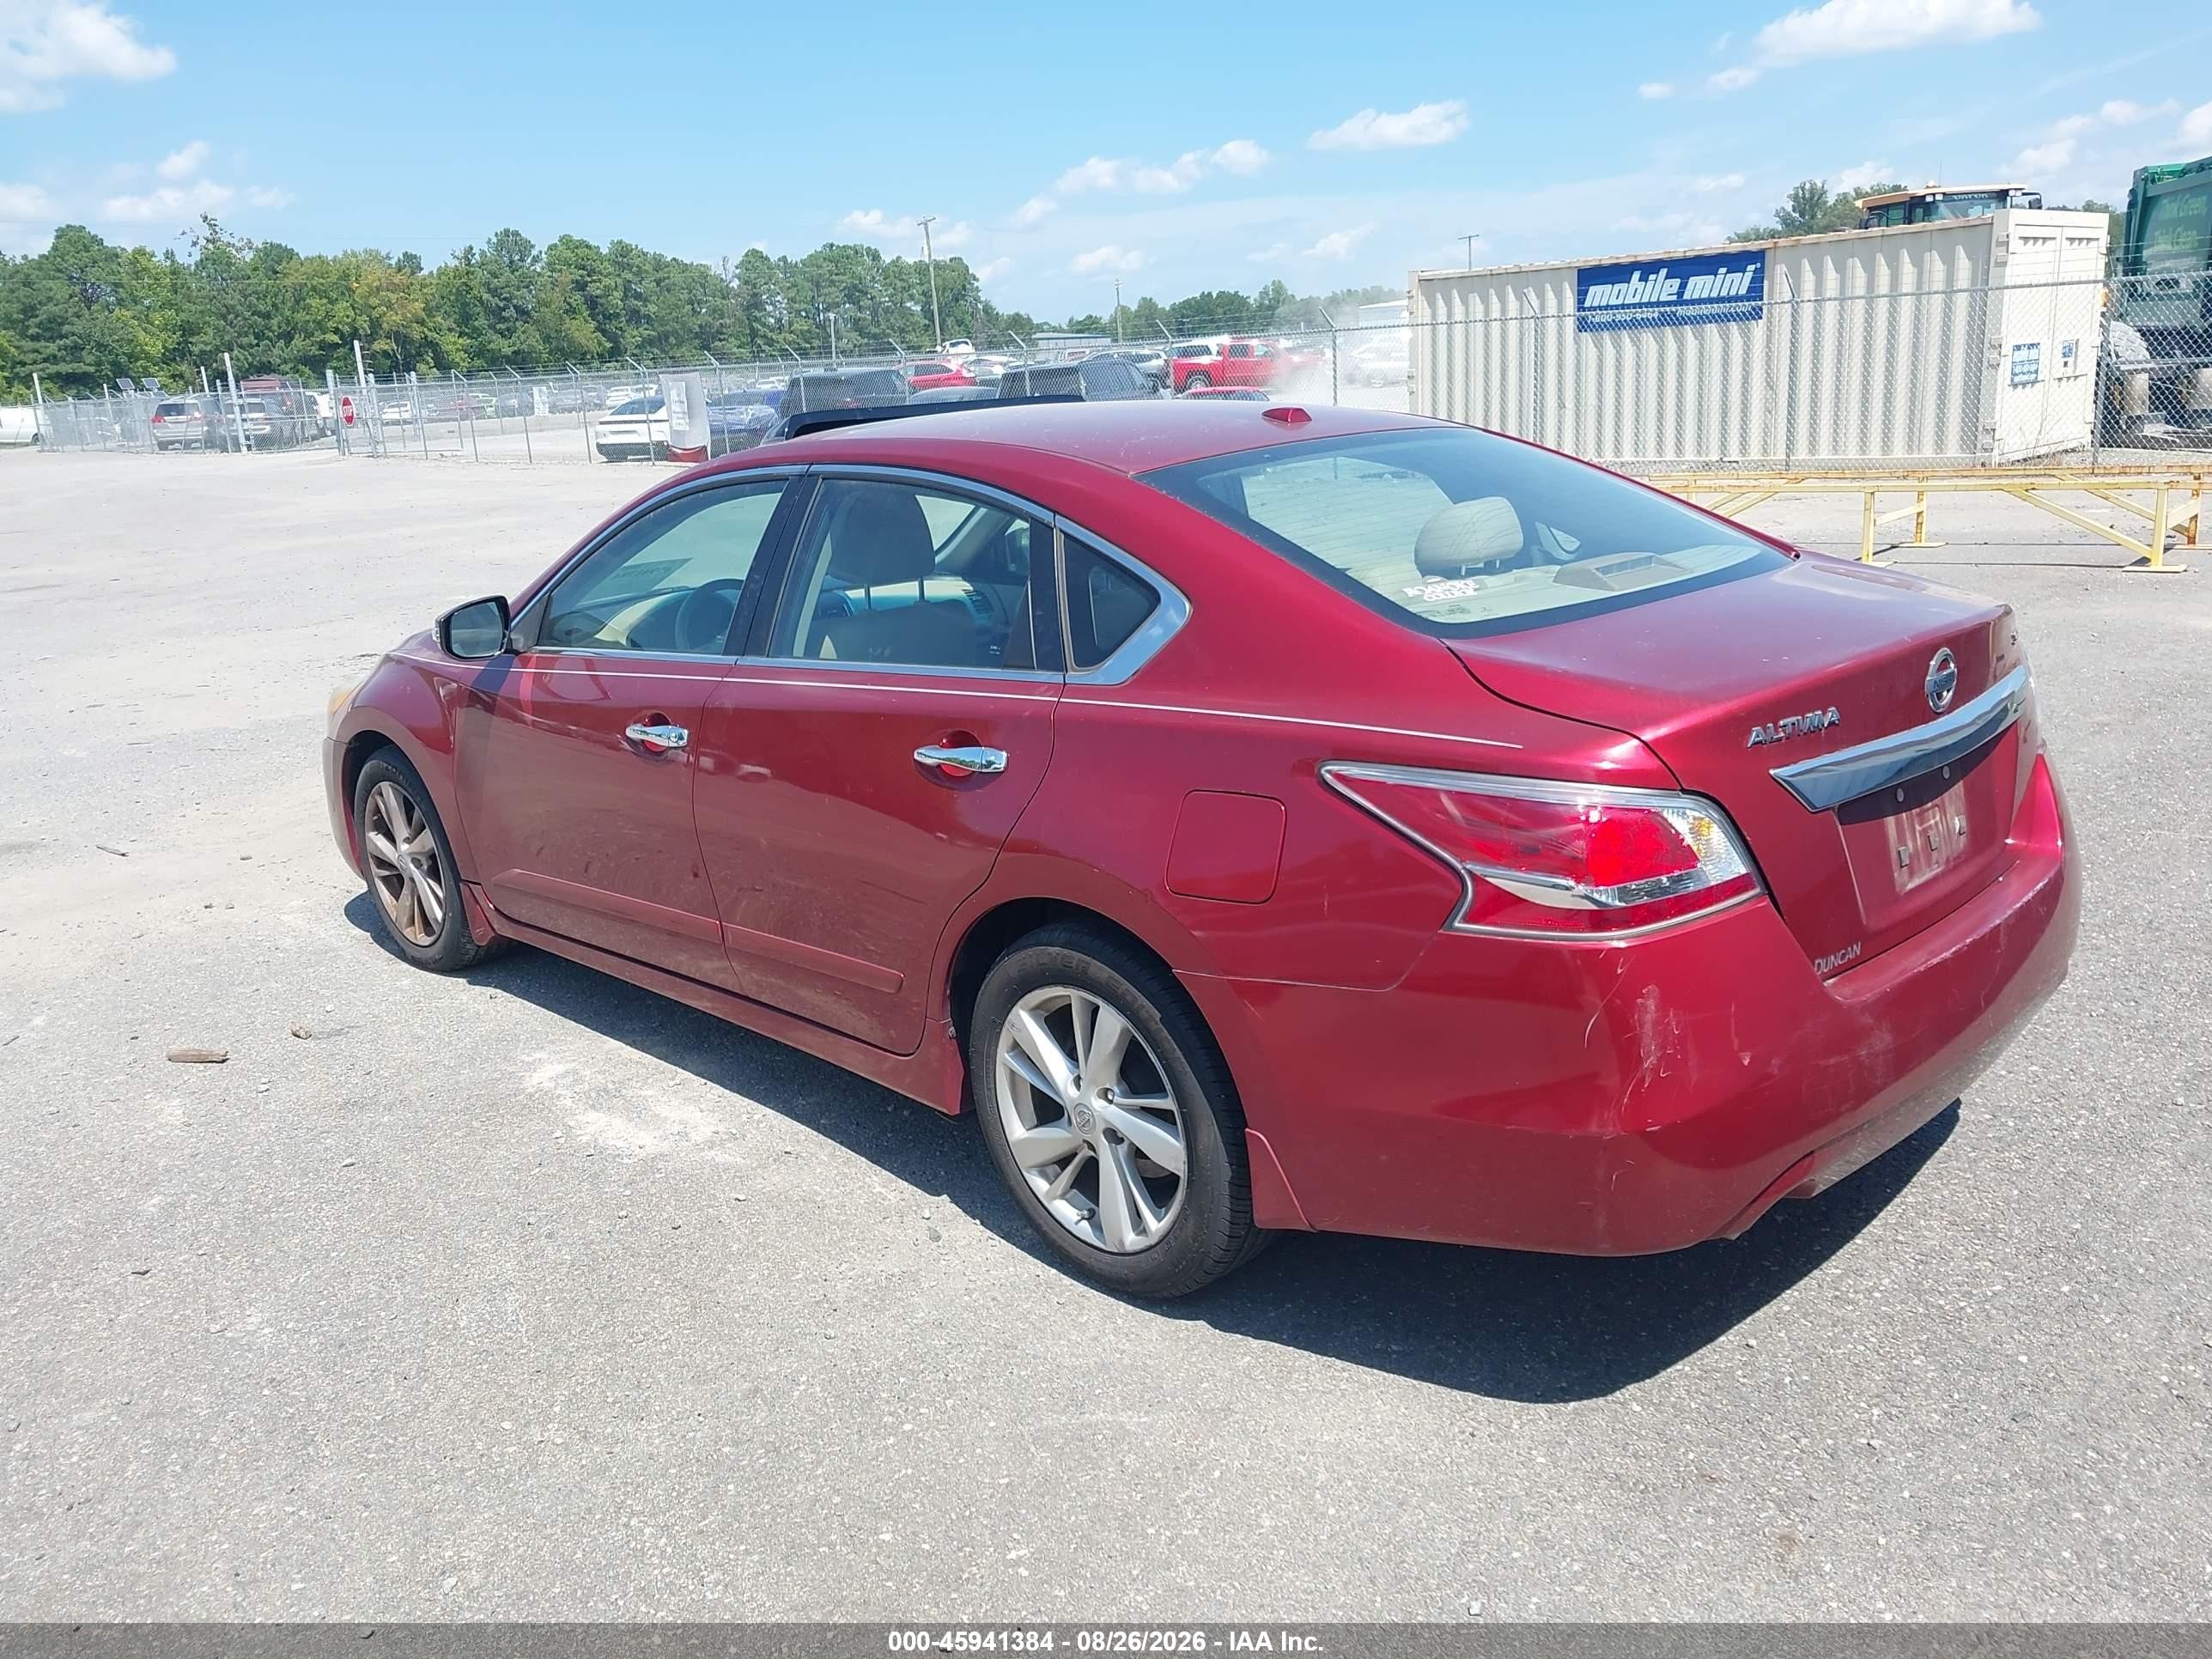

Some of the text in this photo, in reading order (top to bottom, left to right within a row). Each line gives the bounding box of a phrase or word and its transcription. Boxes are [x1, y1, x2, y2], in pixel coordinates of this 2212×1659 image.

[1583, 268, 1680, 307] mobile
[1747, 706, 1840, 748] ALTIMA
[1814, 941, 1862, 975] DUNCAN
